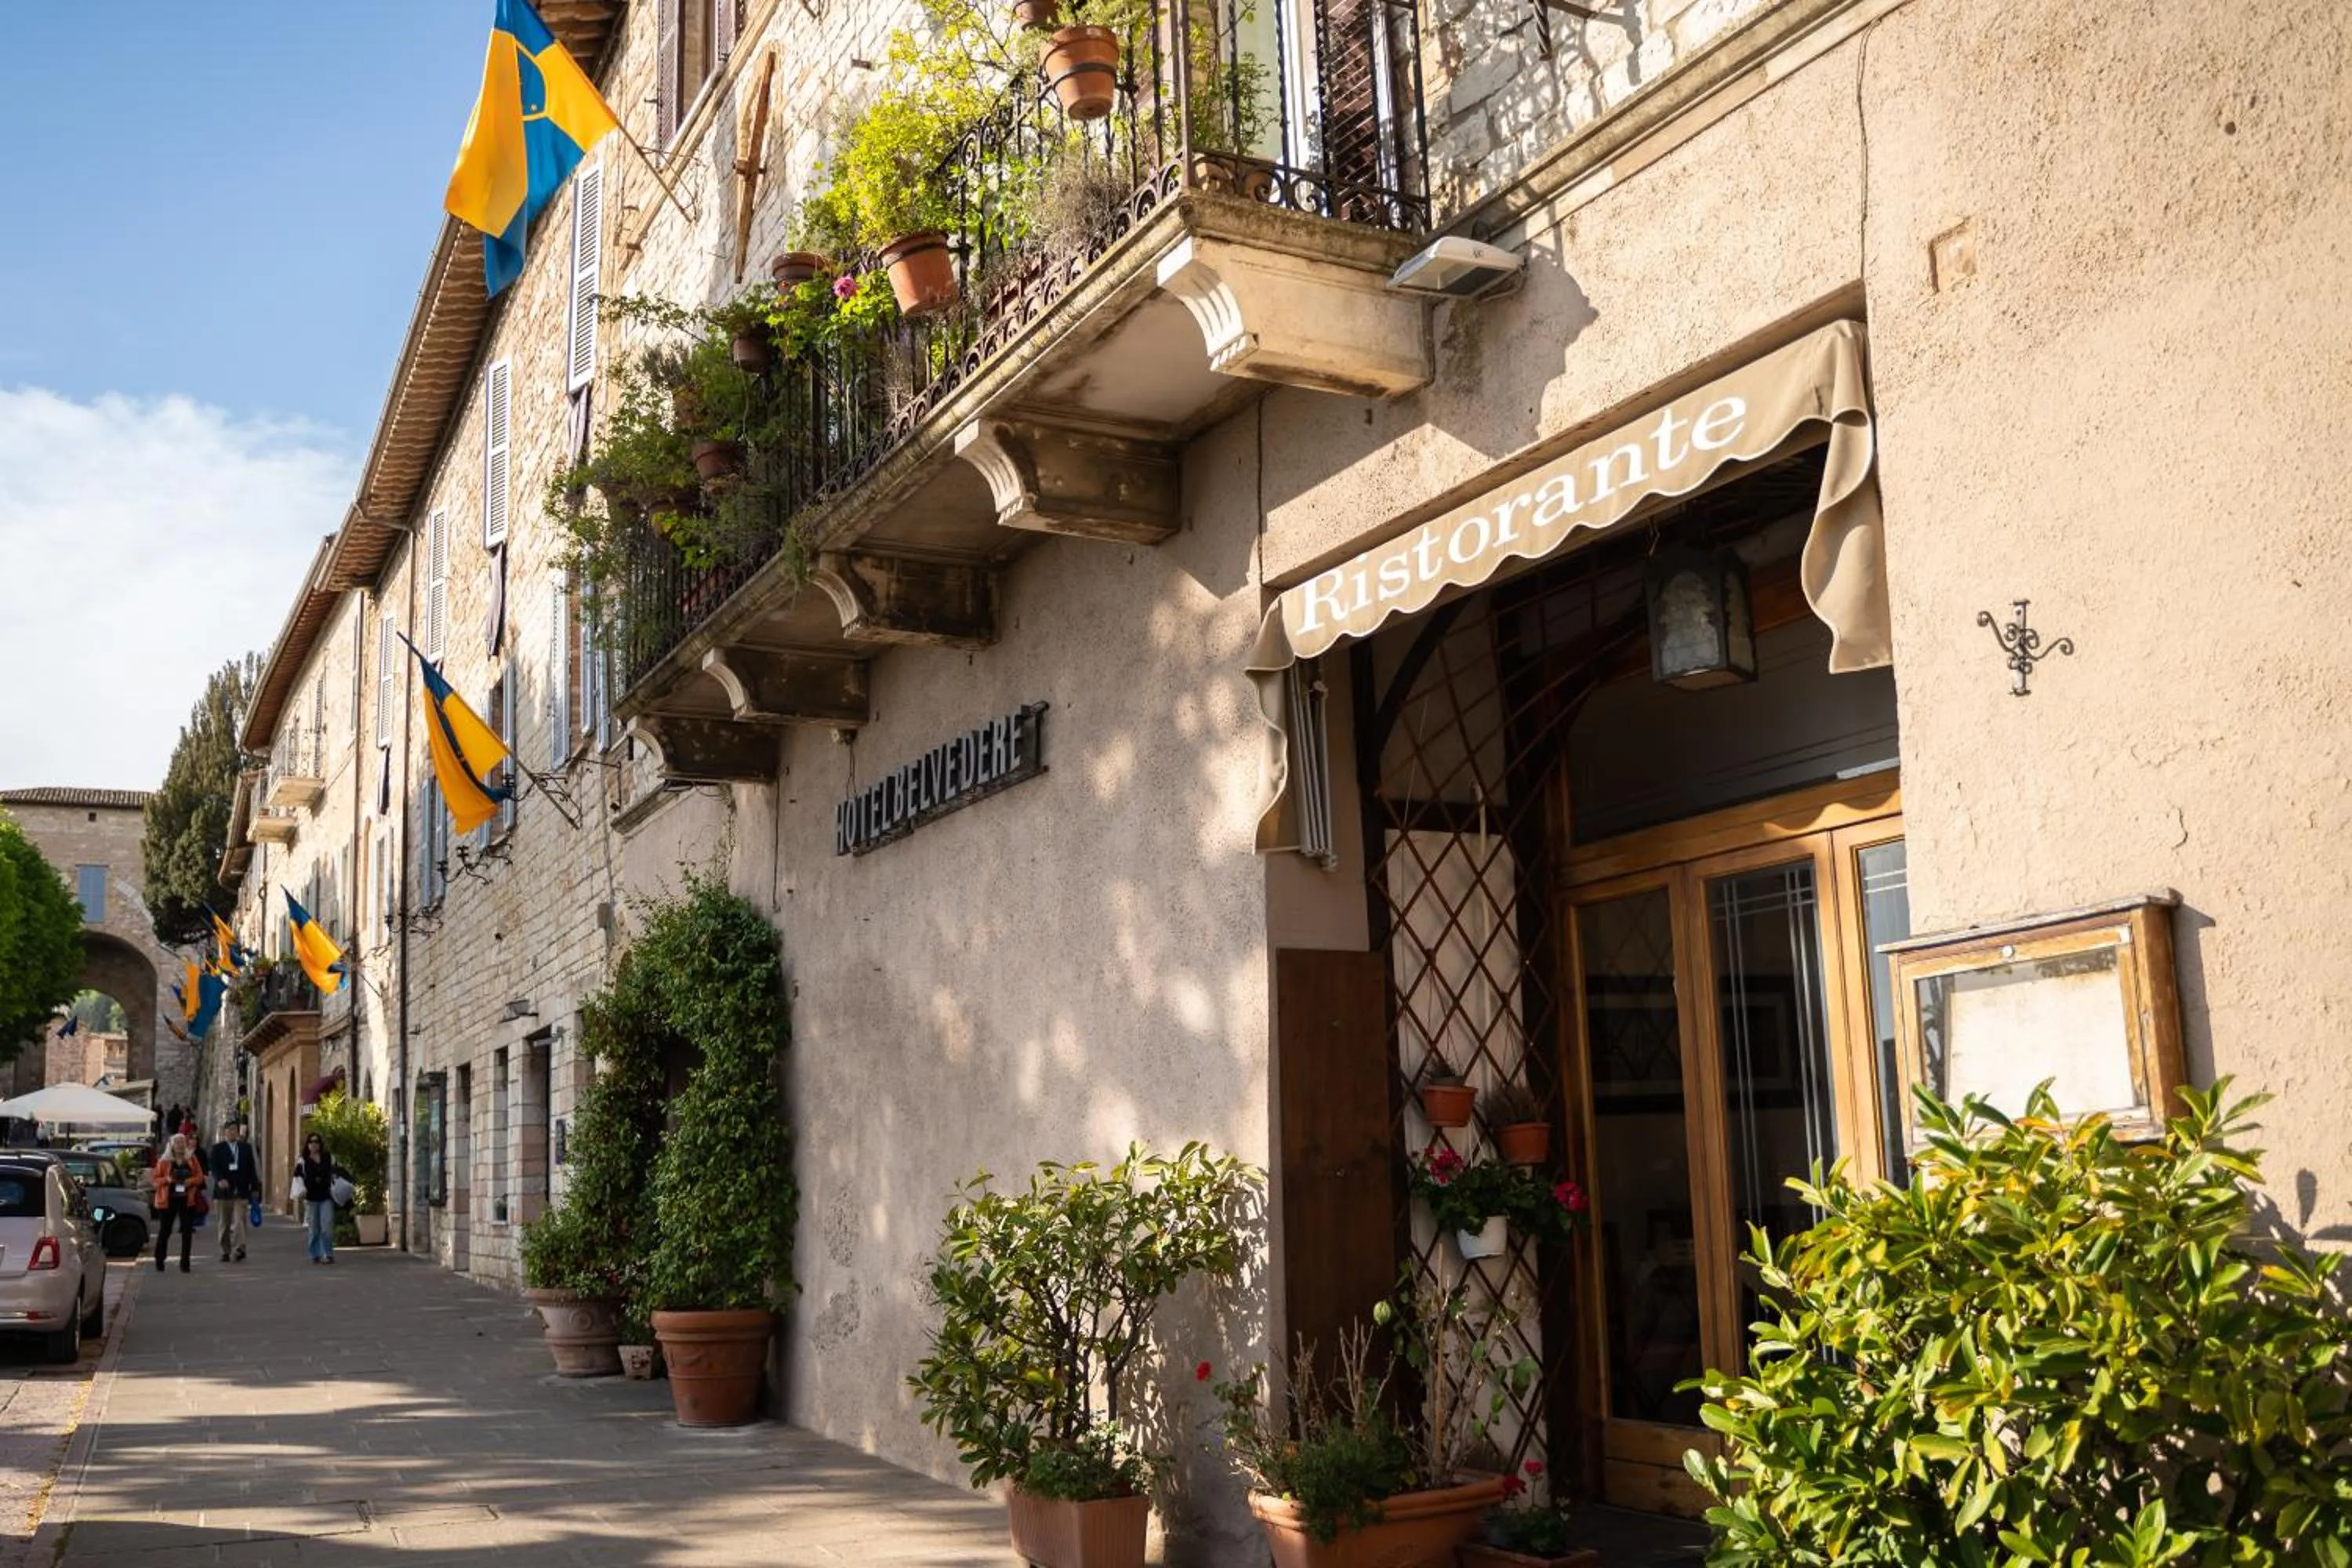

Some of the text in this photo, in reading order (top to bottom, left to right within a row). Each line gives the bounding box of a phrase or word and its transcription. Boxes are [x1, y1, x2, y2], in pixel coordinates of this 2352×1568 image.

[1295, 397, 1746, 636] Ristorante
[835, 710, 1022, 854] HOTEL BELVEDERE
